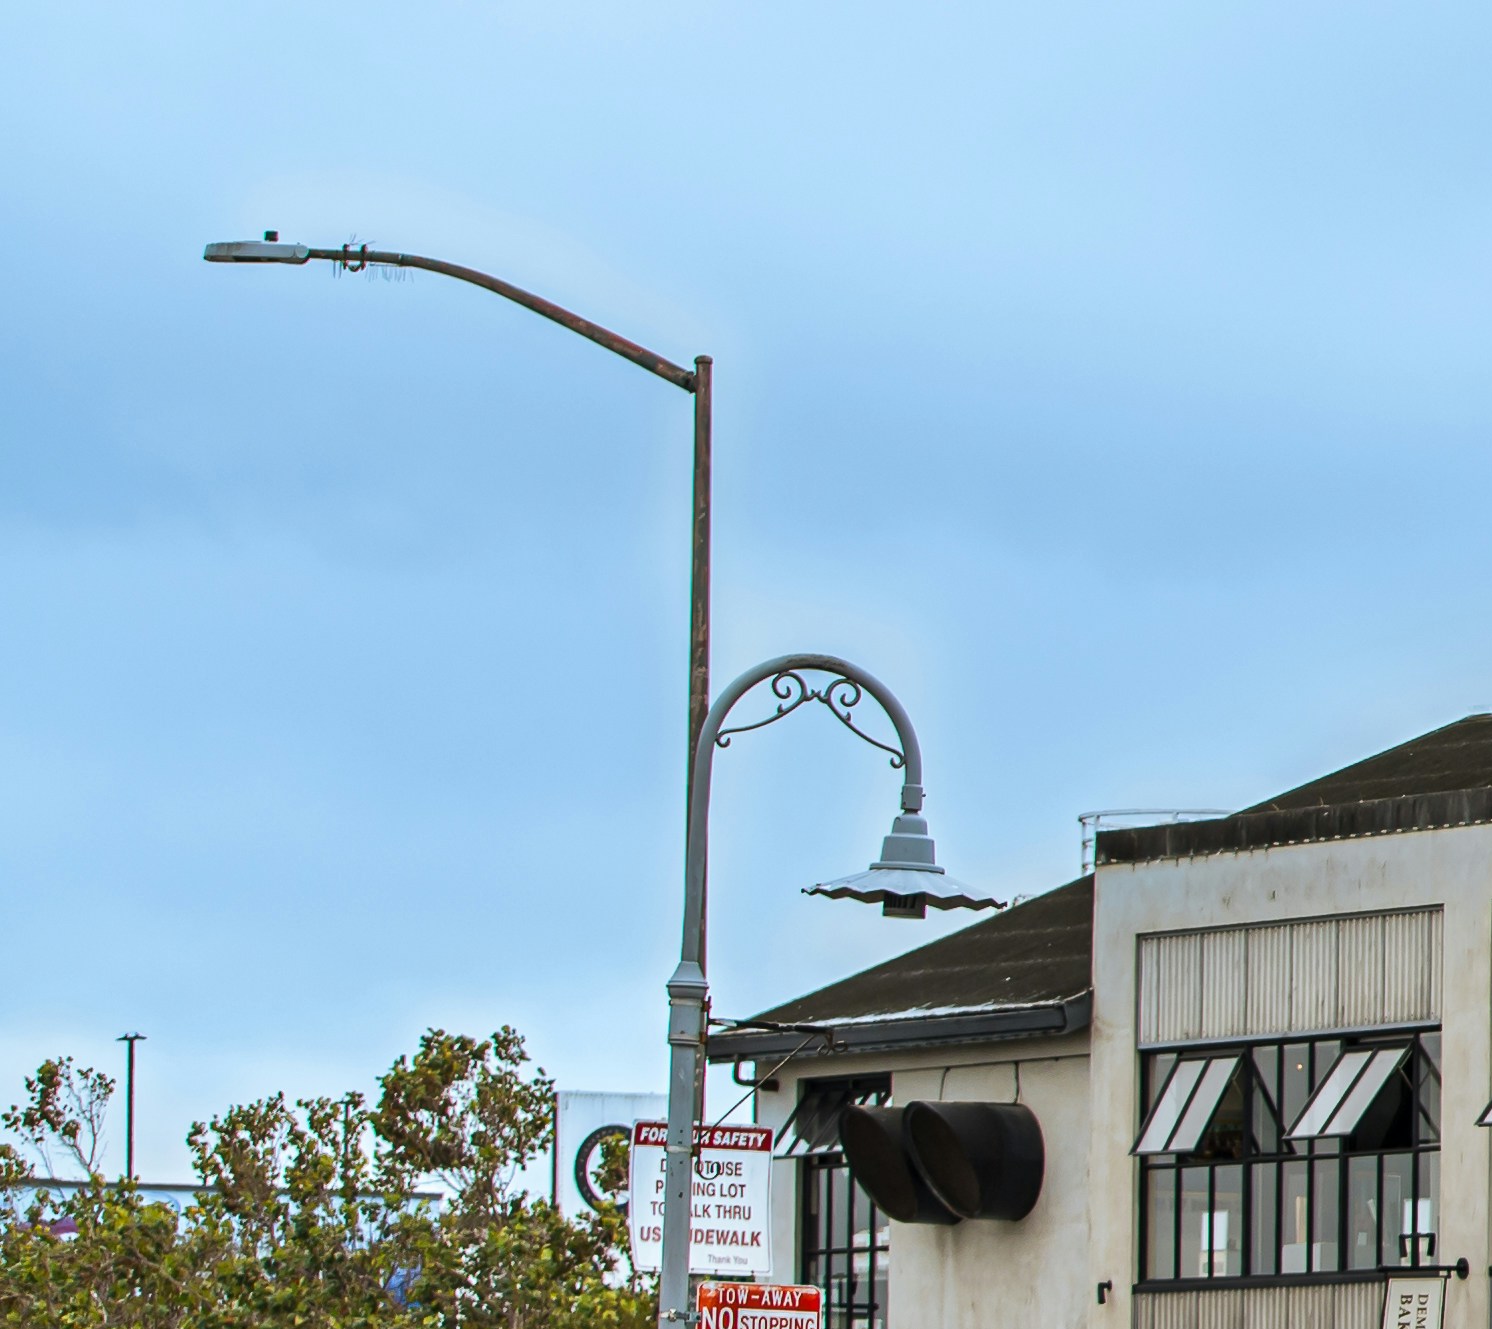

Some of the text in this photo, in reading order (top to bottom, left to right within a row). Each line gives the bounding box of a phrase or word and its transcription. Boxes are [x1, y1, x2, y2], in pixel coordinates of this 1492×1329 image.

[713, 1130, 767, 1147] SAFETY
[656, 1179, 747, 1199] PING LOT
[715, 1204, 751, 1221] THRU
[640, 1226, 662, 1242] US
[708, 1254, 748, 1265] Thank You
[717, 1287, 803, 1308] TOW-AWAY
